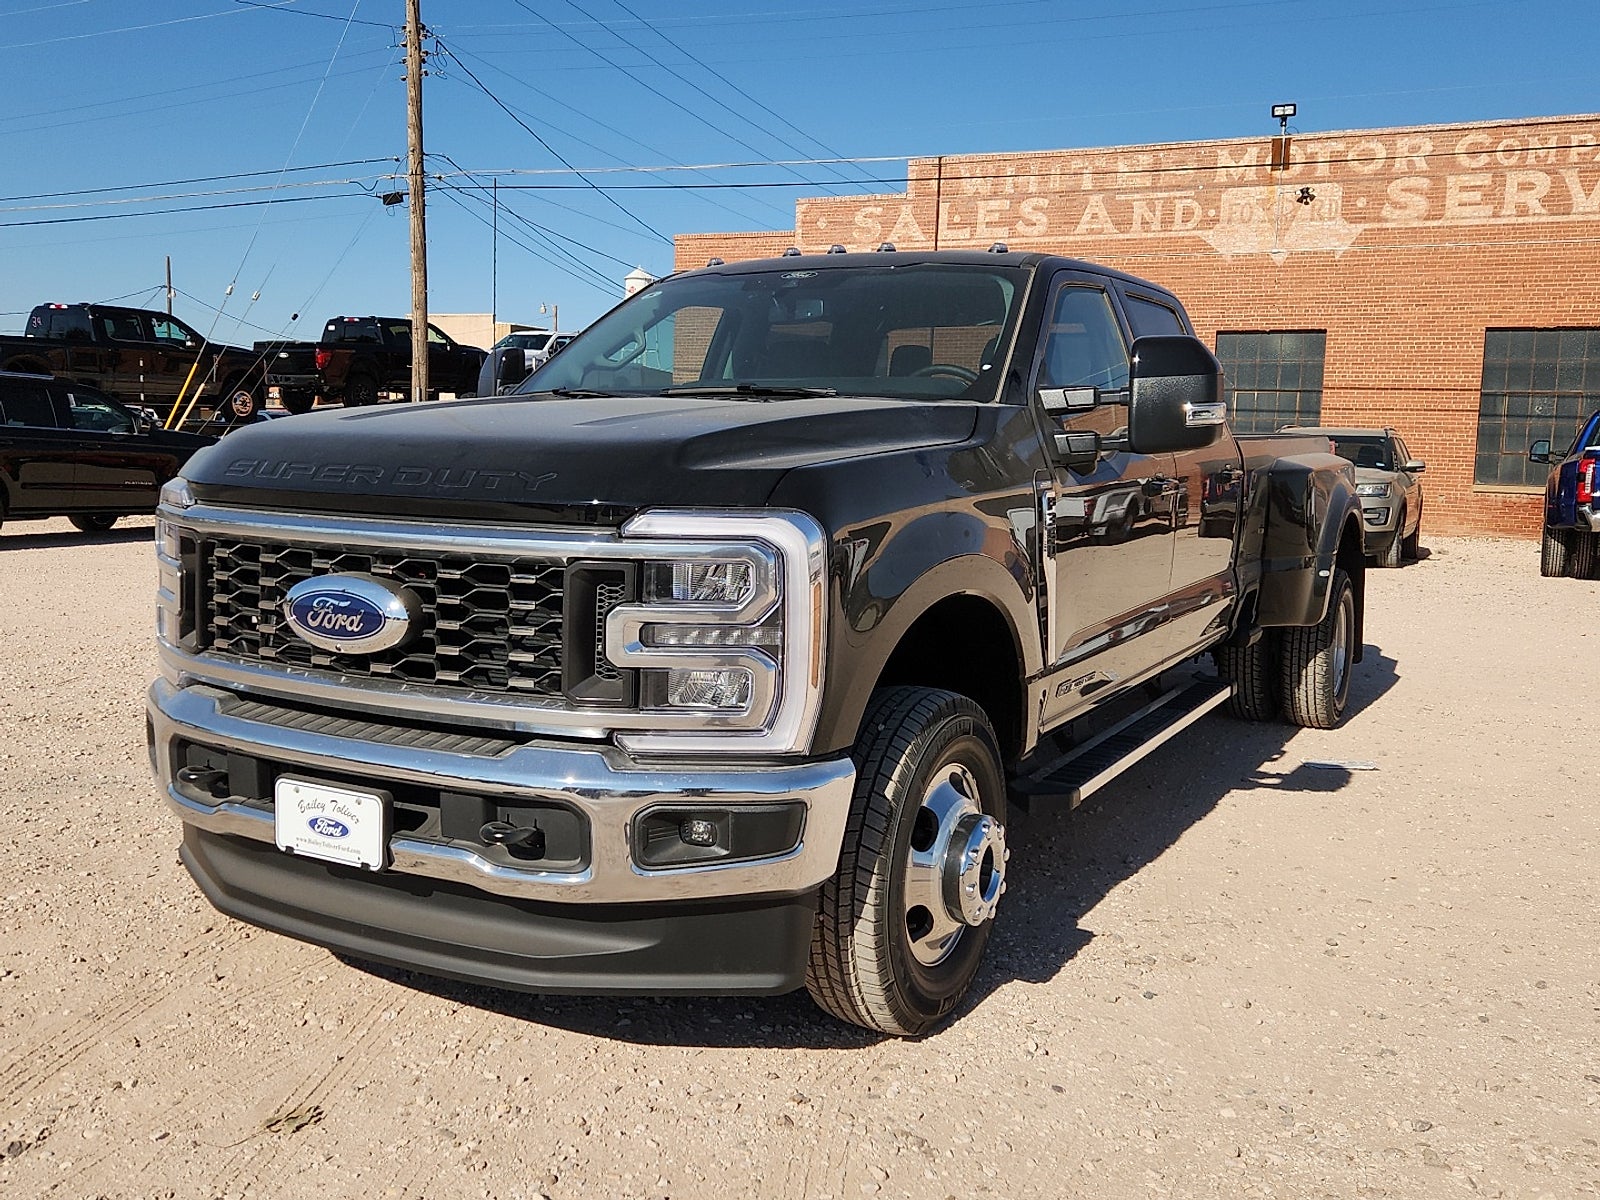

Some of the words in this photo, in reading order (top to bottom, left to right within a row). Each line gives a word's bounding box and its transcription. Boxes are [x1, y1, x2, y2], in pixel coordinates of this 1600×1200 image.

[1213, 136, 1433, 184] MOTOR
[1455, 132, 1600, 168] COMP
[852, 197, 1050, 242] SALES
[1073, 194, 1202, 235] AND
[224, 458, 386, 486] SUPER
[391, 467, 559, 492] DUTY
[307, 597, 364, 632] Ford
[298, 799, 326, 813] Bailey
[330, 799, 359, 824] Toliver
[315, 818, 342, 836] Ford
